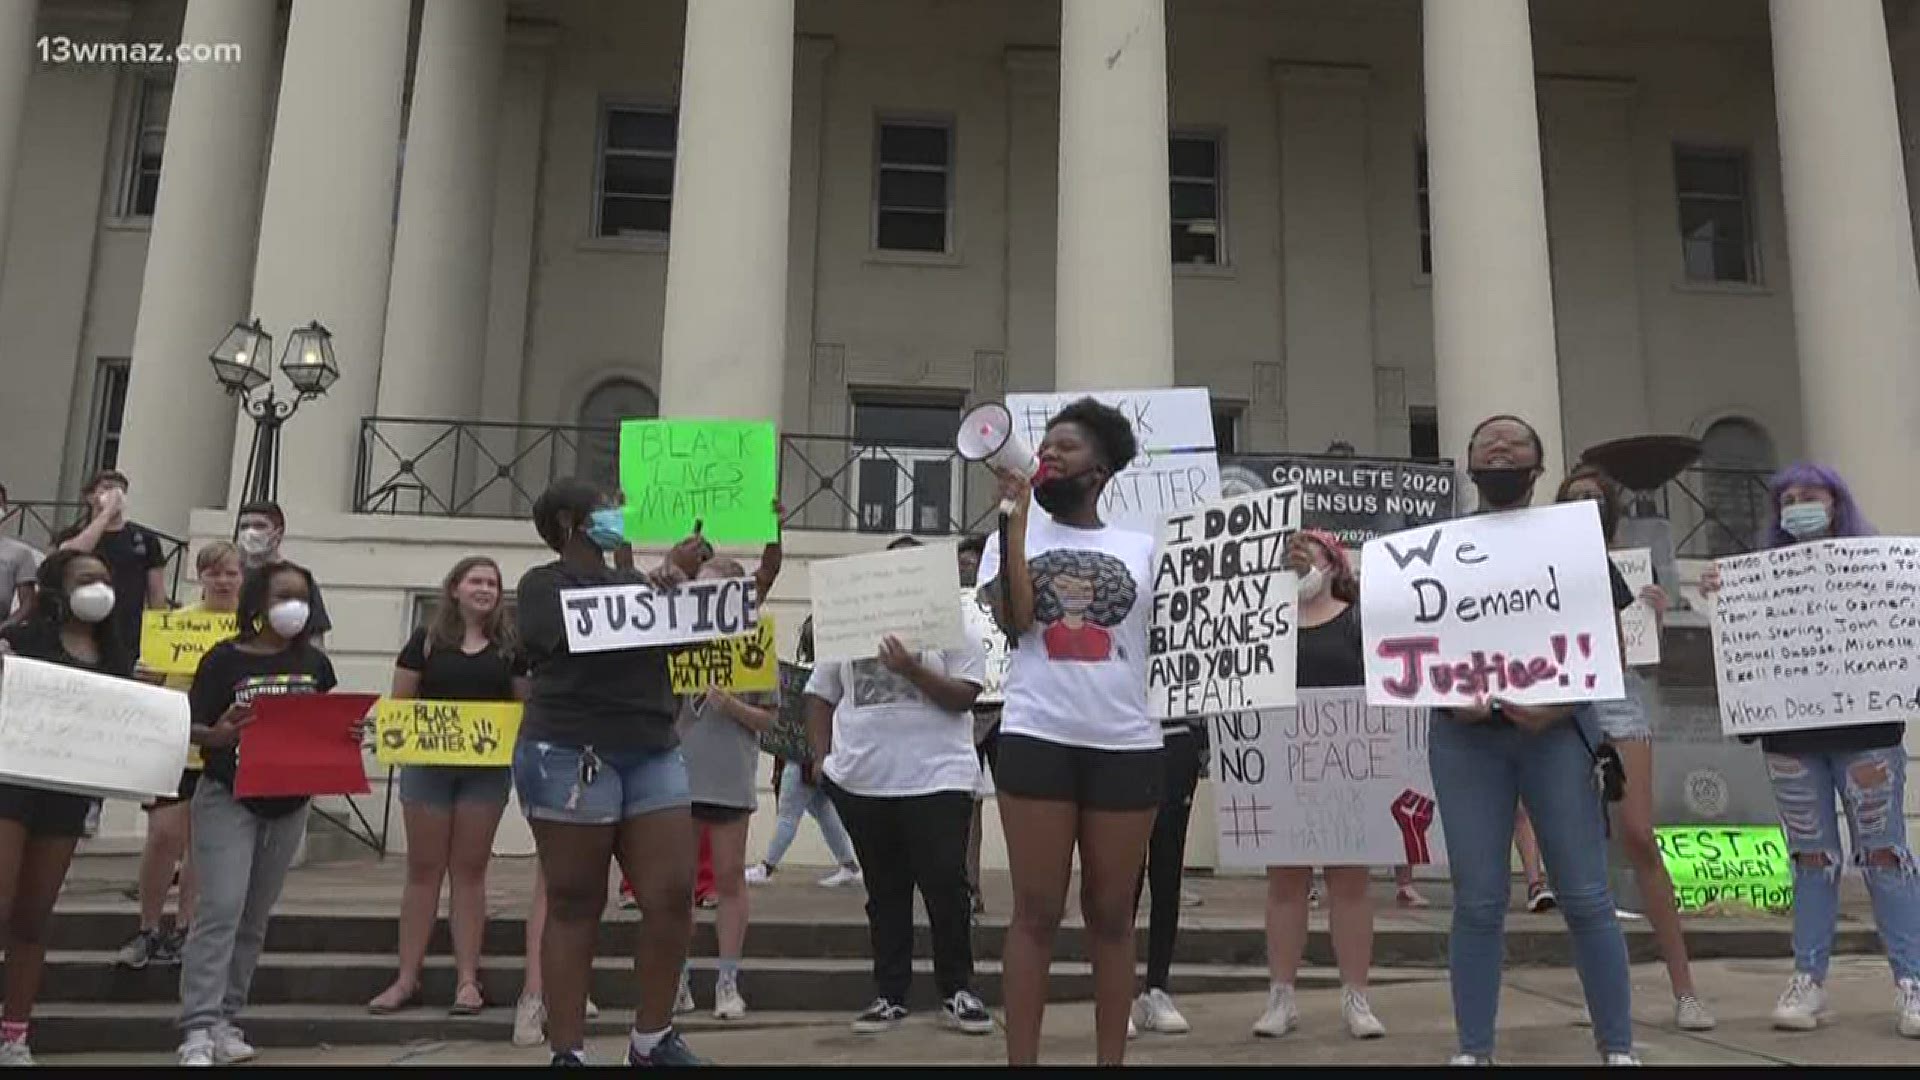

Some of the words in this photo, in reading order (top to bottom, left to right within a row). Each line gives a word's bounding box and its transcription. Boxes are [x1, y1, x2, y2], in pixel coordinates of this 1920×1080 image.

[641, 424, 754, 462] BLACK
[654, 461, 744, 487] LIVES
[1272, 466, 1394, 489] COMPLETE
[1402, 472, 1449, 494] 2020
[640, 485, 745, 523] MATTER
[1168, 515, 1195, 545] I
[1205, 490, 1298, 540] DONT
[1303, 492, 1377, 514] ENSUS
[1386, 496, 1436, 518] NOW
[1384, 529, 1489, 570] We
[567, 580, 759, 636] JUSTICE
[1153, 586, 1211, 625] FOR
[1221, 576, 1270, 614] MY
[1411, 566, 1561, 622] Demand
[1150, 602, 1290, 655] BLACKNESS
[672, 667, 734, 688] MATTER
[1150, 652, 1200, 688] AND
[1205, 643, 1274, 679] YOUR
[1377, 633, 1598, 698] Justice!!
[414, 703, 460, 722] BLACK
[1215, 711, 1261, 742] NO
[1285, 702, 1398, 738] JUSTICE
[1726, 700, 1777, 726] When
[1785, 697, 1825, 720] Does
[1832, 691, 1855, 714] It
[415, 733, 466, 751] MATTER
[1220, 748, 1265, 785] NO
[1287, 738, 1393, 784] PEACE
[1655, 831, 1742, 860] REST
[1755, 840, 1782, 859] in
[1692, 858, 1775, 881] HEAVEN
